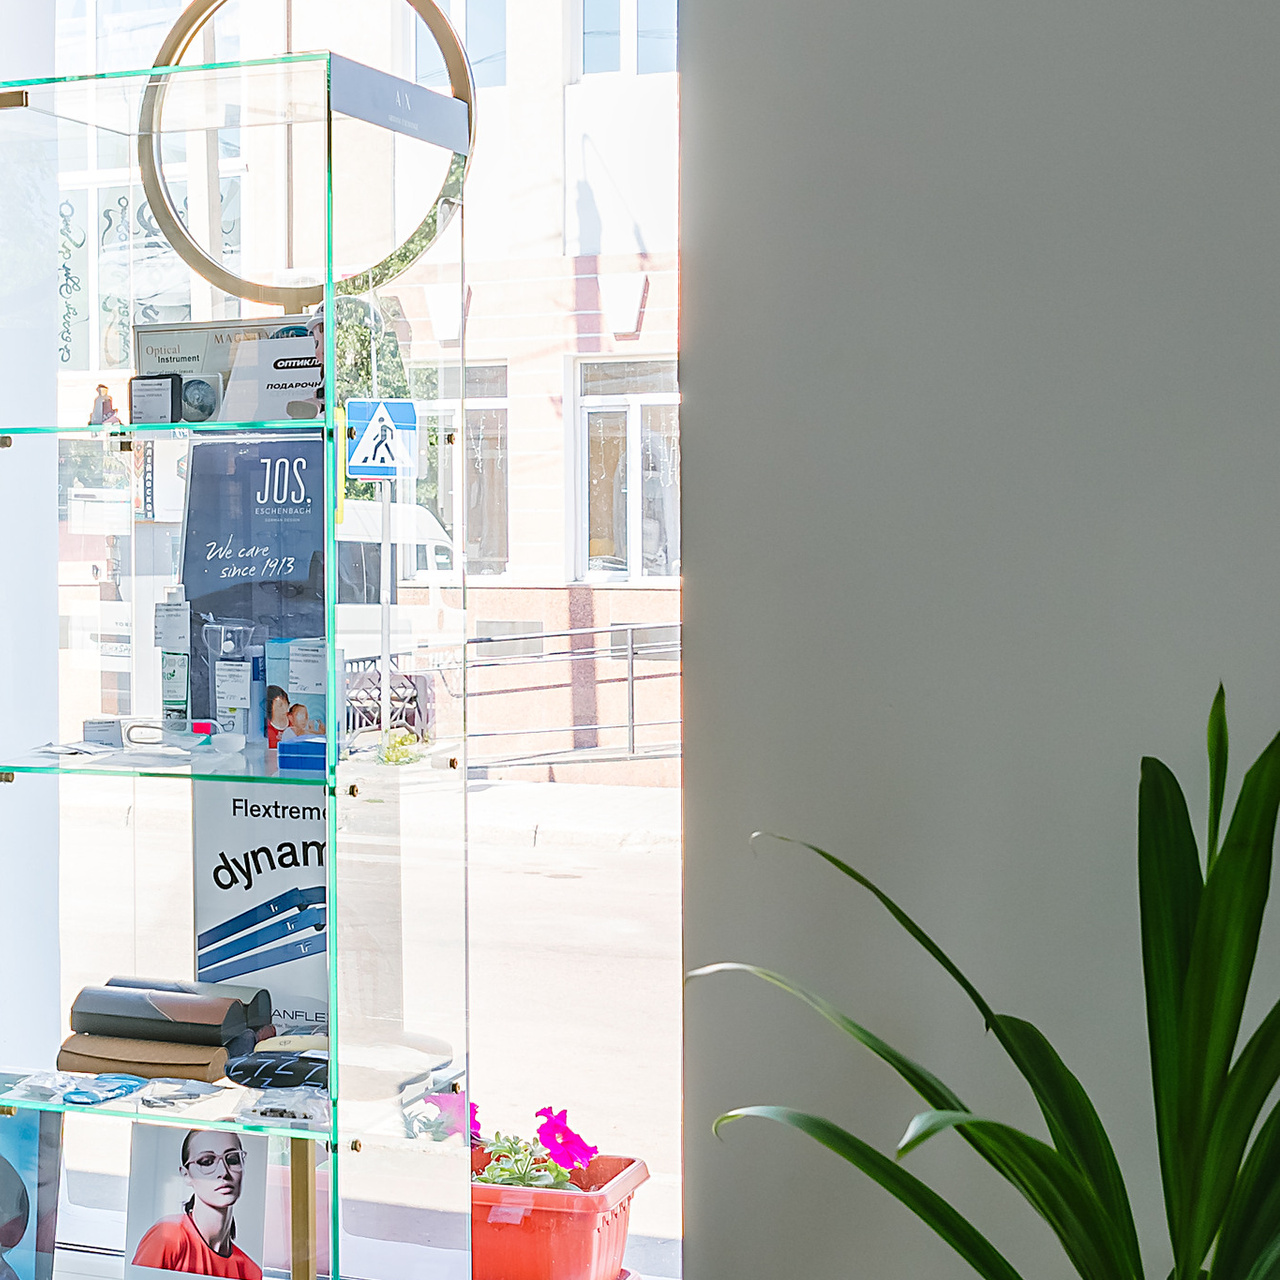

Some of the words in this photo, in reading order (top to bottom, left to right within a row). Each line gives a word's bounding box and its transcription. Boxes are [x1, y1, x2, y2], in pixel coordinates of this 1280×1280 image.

[145, 344, 181, 357] Optical
[157, 354, 200, 364] Instrument
[256, 458, 312, 504] JOS.
[255, 507, 311, 515] ESCHENBACH
[206, 534, 234, 561] We
[238, 545, 270, 558] care
[220, 564, 256, 578] since
[261, 557, 295, 577] 1913
[272, 1008, 328, 1022] ANFLE
